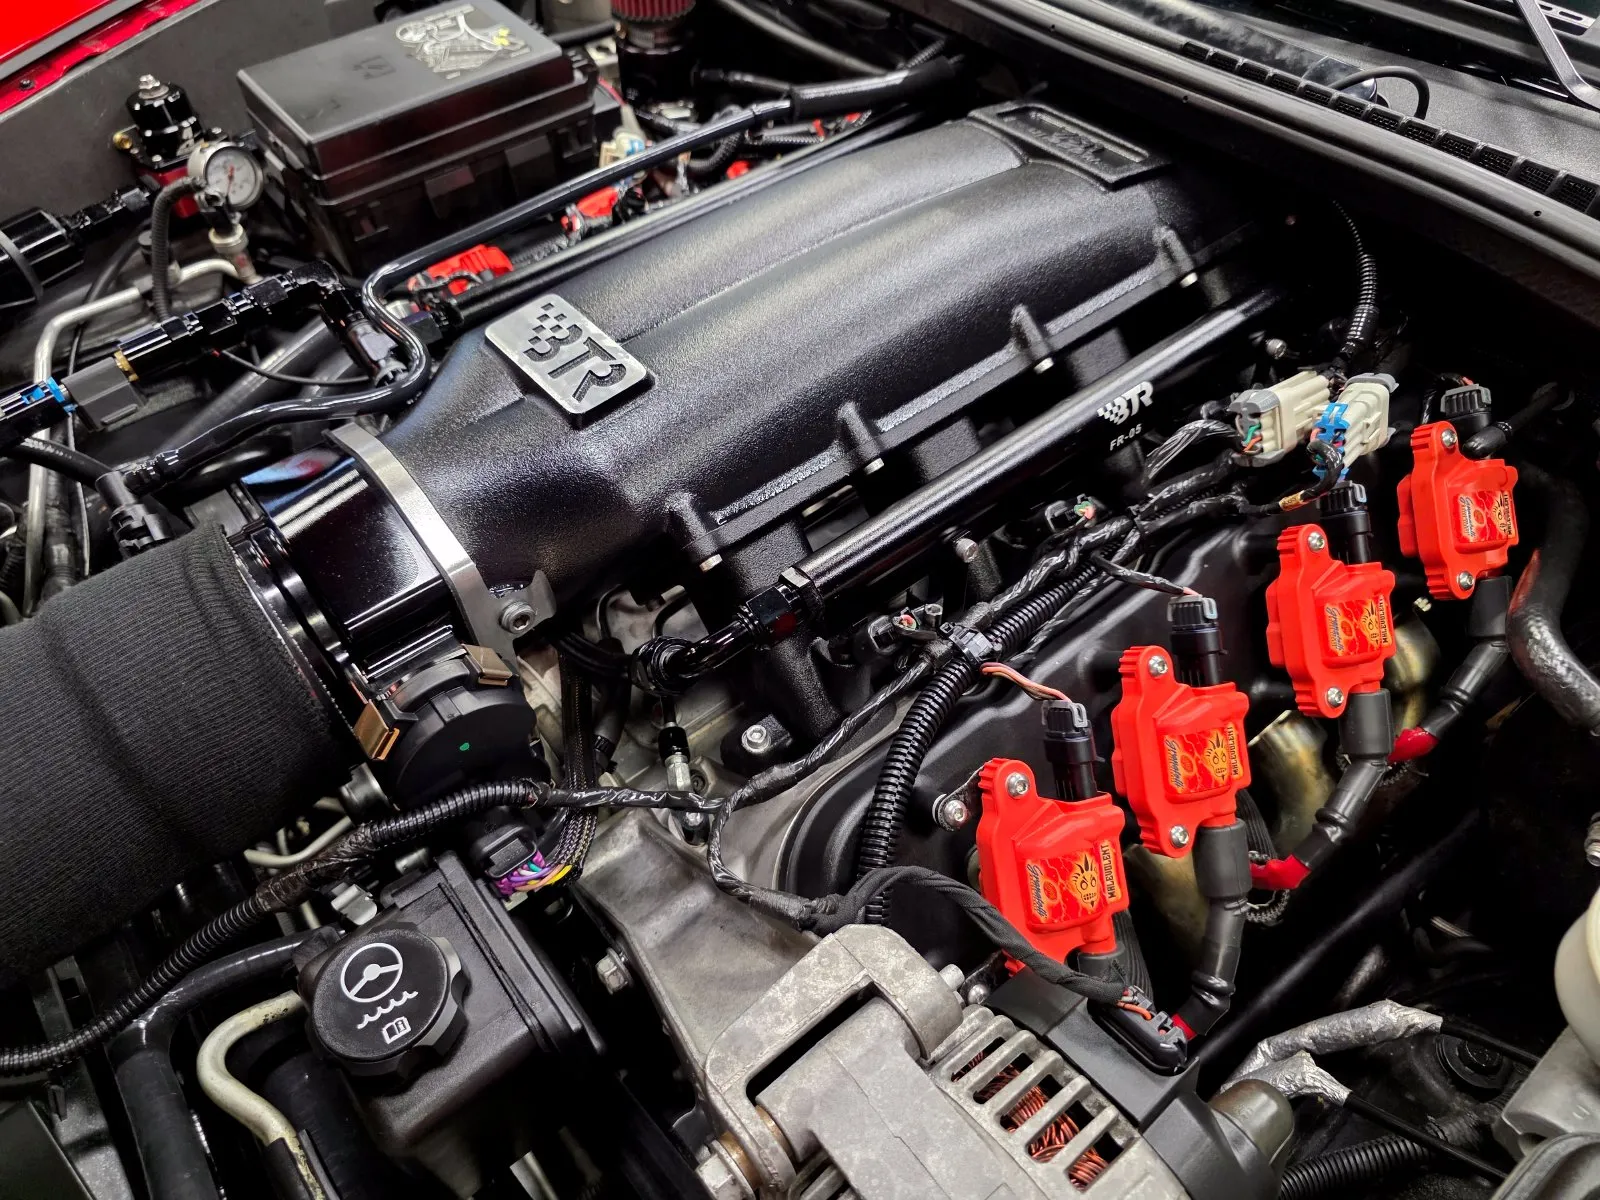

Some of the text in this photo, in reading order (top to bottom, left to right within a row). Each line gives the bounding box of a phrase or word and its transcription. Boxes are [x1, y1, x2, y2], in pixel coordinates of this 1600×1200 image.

[523, 303, 627, 403] BTR
[1097, 381, 1154, 426] BTR
[1109, 423, 1142, 451] FR-05
[1101, 844, 1117, 899] MALEVOLENT
